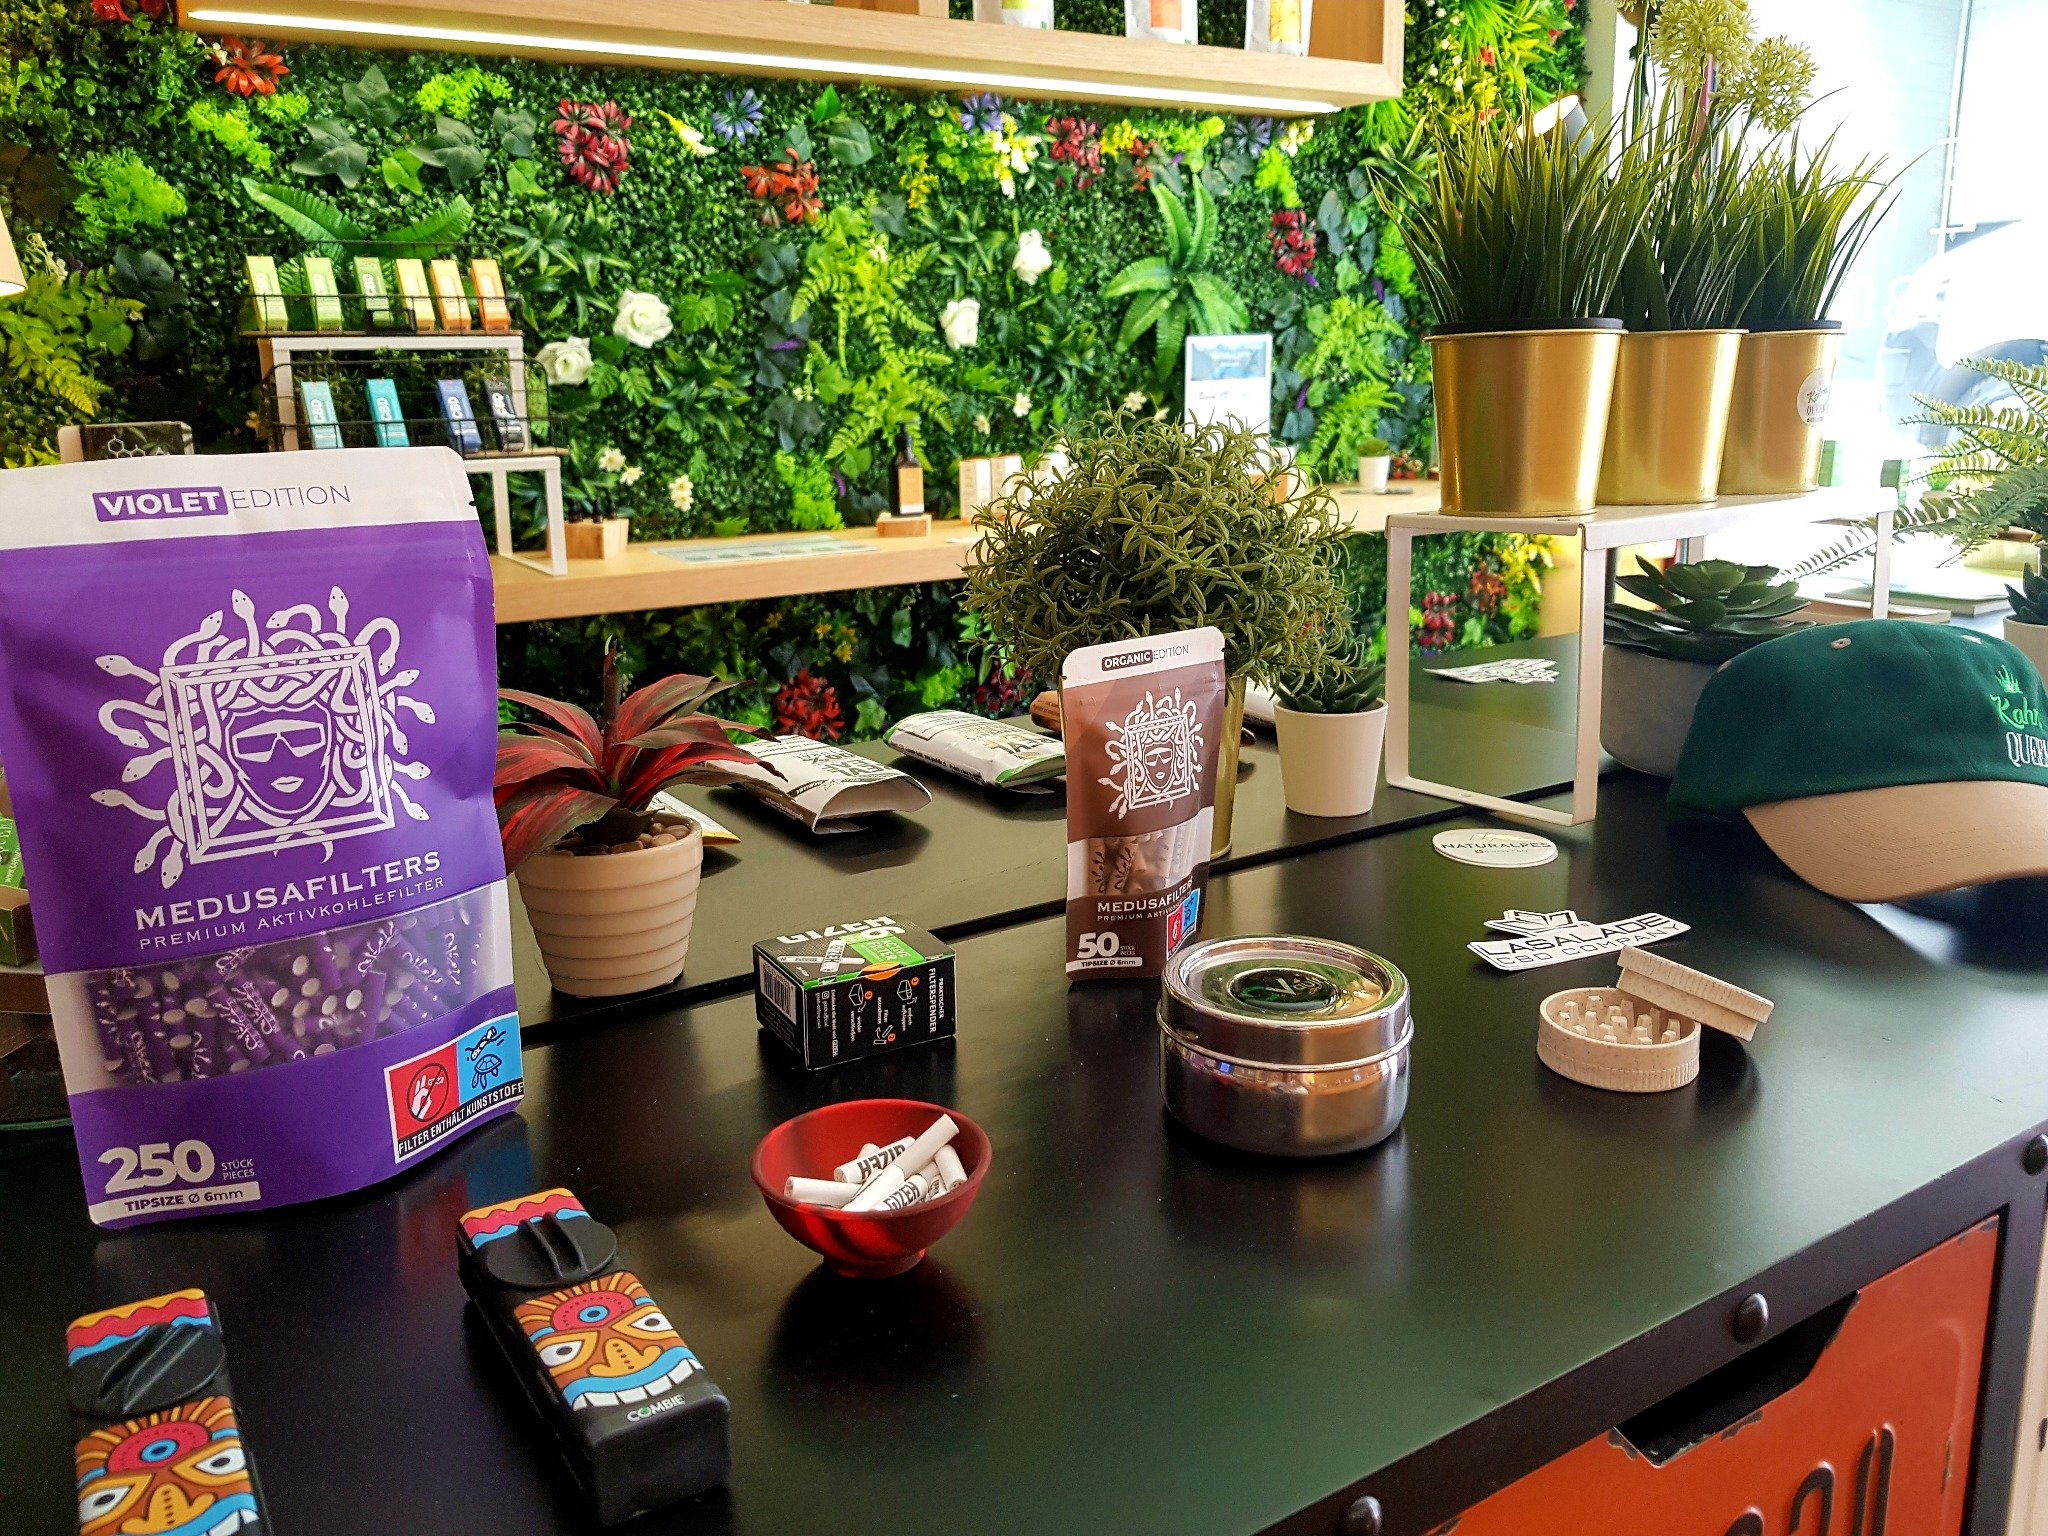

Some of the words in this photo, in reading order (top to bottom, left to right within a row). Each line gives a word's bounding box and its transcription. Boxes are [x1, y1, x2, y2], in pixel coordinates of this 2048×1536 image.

[311, 399, 326, 423] CBD
[377, 397, 392, 422] CBD
[448, 396, 463, 419] CBD
[99, 491, 220, 517] VIOLET
[231, 485, 351, 510] EDITION
[1104, 651, 1151, 669] ORGANIC
[1153, 645, 1189, 660] EDITION
[134, 850, 442, 931] MEDUSAFILTERS
[139, 922, 247, 951] PREMIUM
[256, 876, 445, 931] AKTIVKOHLEFILTER
[1097, 913, 1143, 921] PREMIUM
[777, 916, 897, 944] GIZEH
[1477, 914, 1671, 956] LASALADE
[1077, 931, 1120, 959] 50
[1497, 951, 1551, 965] CBD
[1563, 924, 1680, 956] COMPANY
[1081, 959, 1109, 967] TIPSIZE
[929, 967, 937, 1034] FILTERSPENDER
[398, 1130, 430, 1156] FILTER
[431, 1107, 466, 1138] ENTHÄLT
[466, 1081, 524, 1117] KUNSTSTOFF
[97, 1139, 216, 1195] 250
[221, 1157, 255, 1172] STÜCK
[222, 1167, 256, 1180] PIECES
[124, 1194, 185, 1213] TIPSIZE
[204, 1187, 244, 1202] 6mm
[884, 1181, 920, 1212] GIZEH
[627, 1394, 686, 1421] COMBIE
